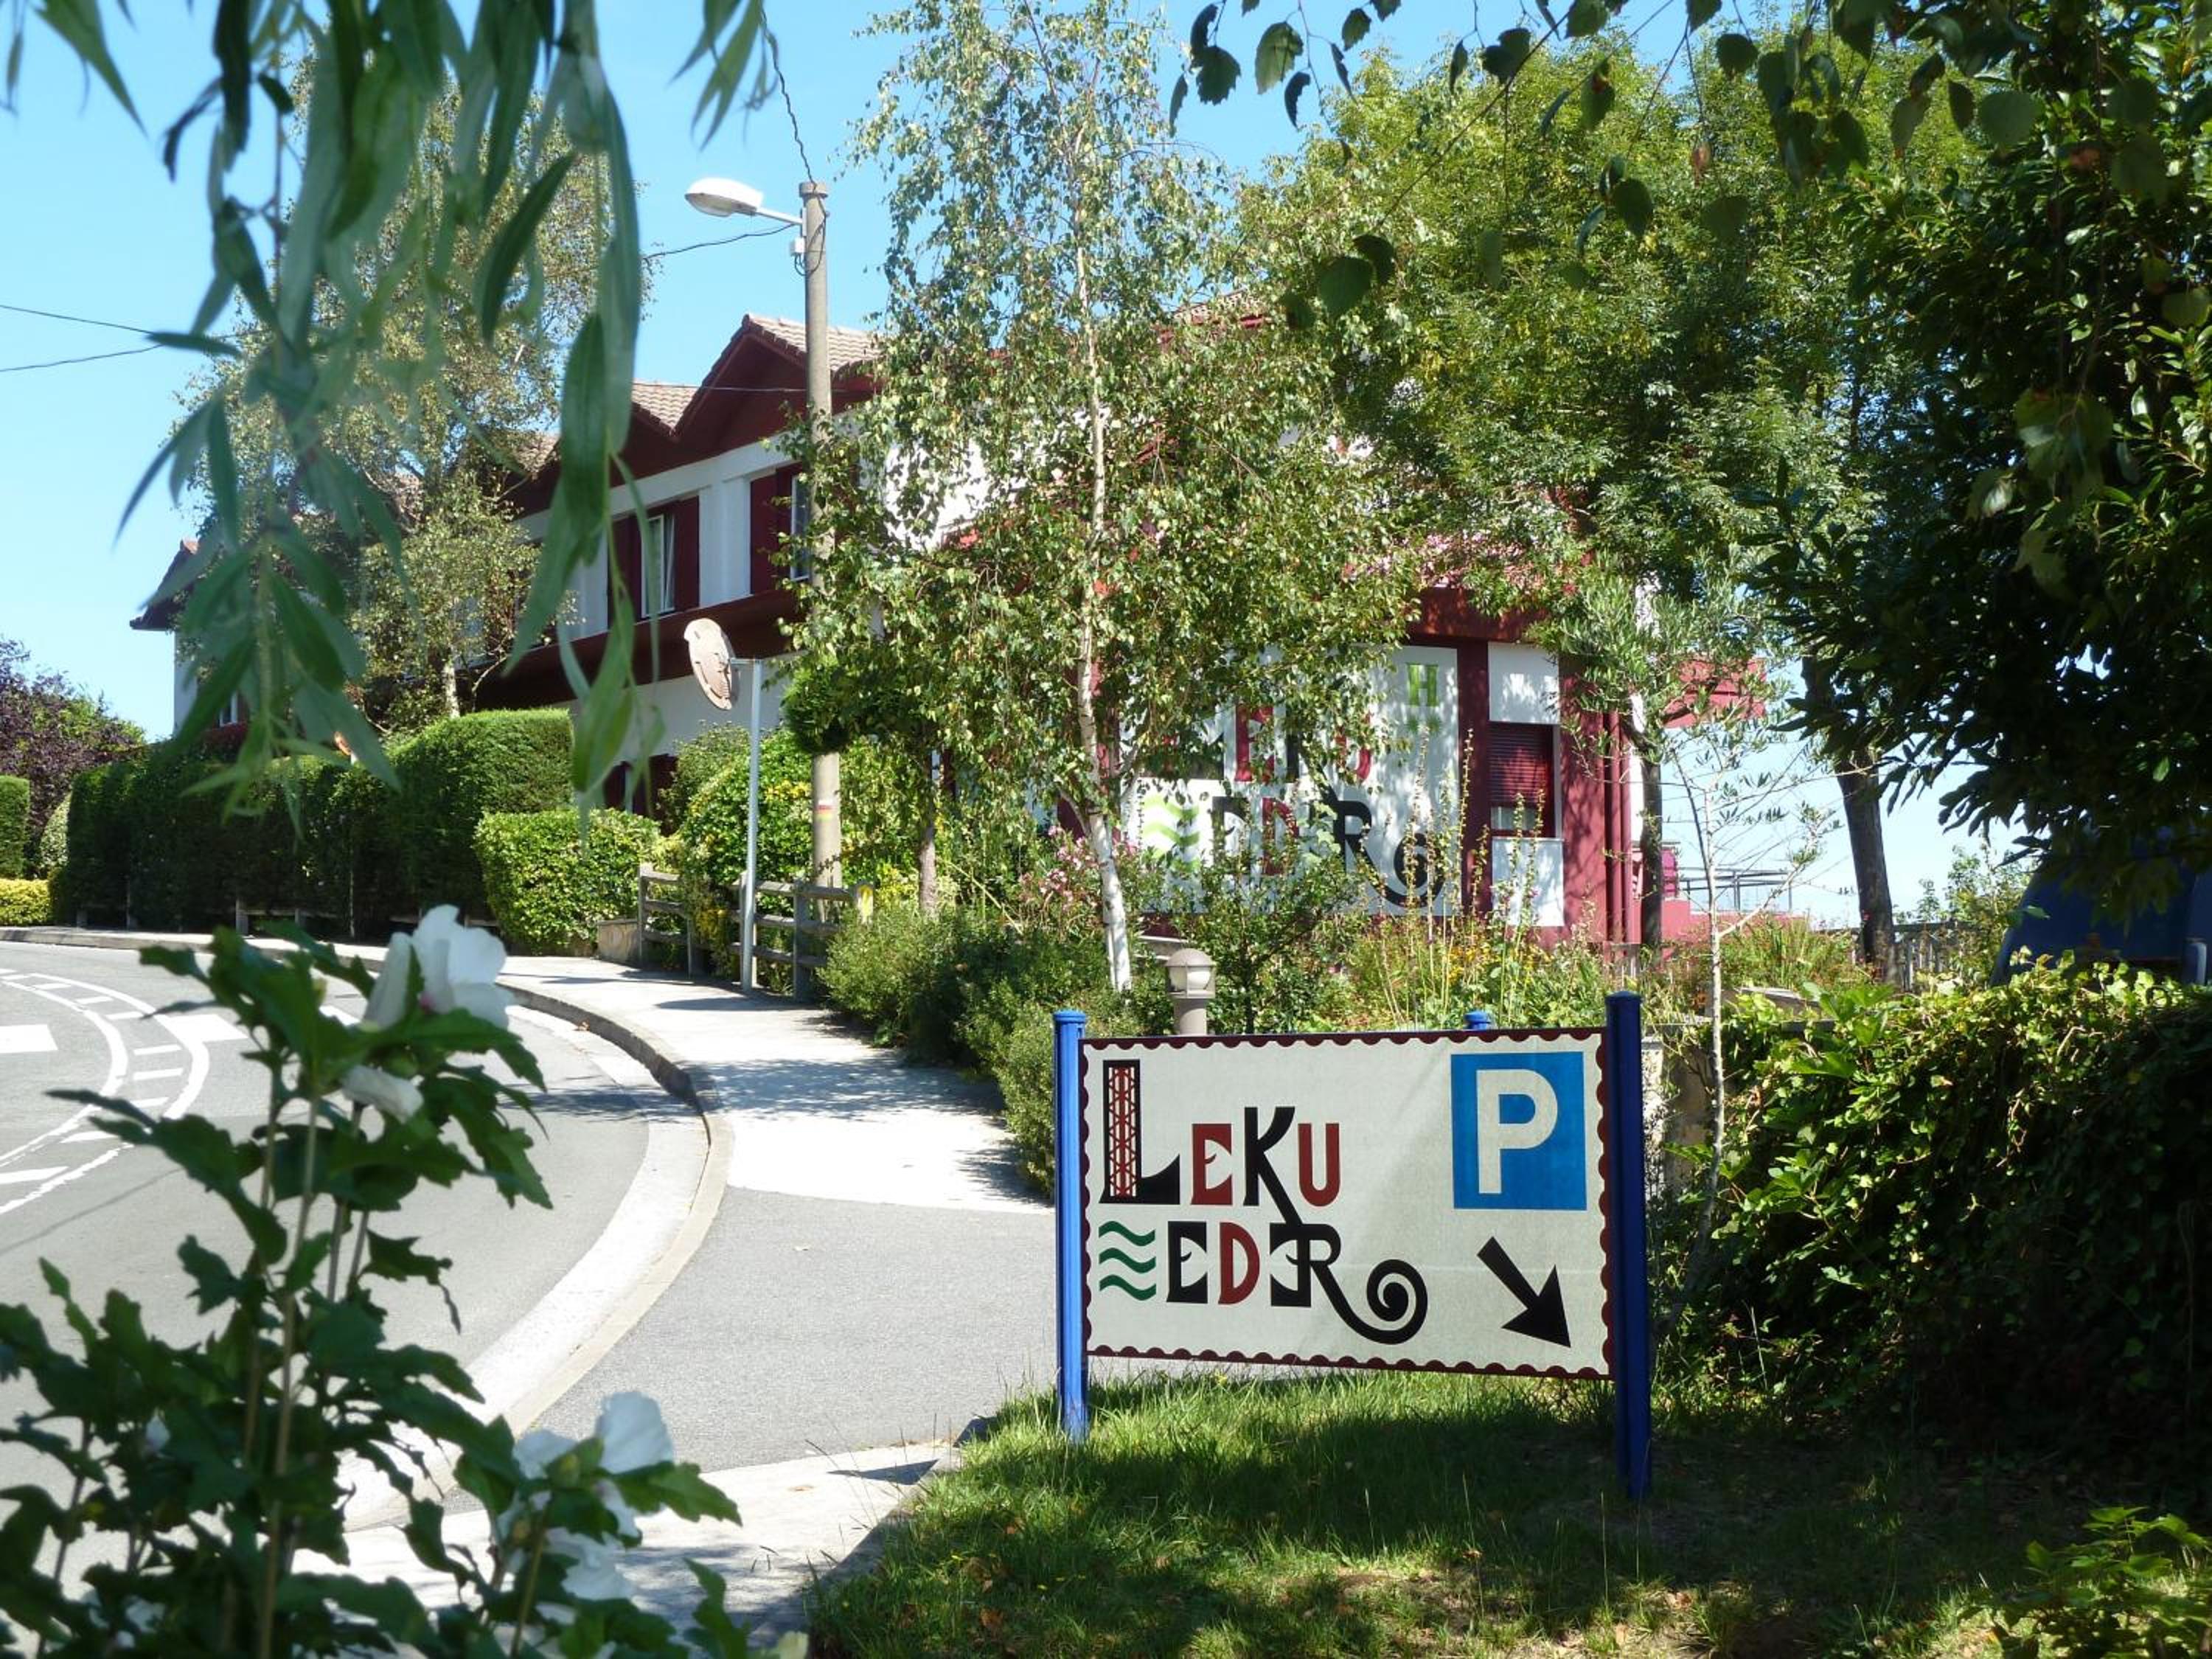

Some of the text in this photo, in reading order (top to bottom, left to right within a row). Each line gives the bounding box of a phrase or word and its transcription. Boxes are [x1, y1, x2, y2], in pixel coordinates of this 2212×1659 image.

[1405, 663, 1439, 706] H
[1099, 1059, 1340, 1218] LEKU
[1476, 1068, 1558, 1194] P
[1166, 1220, 1428, 1345] EDER
